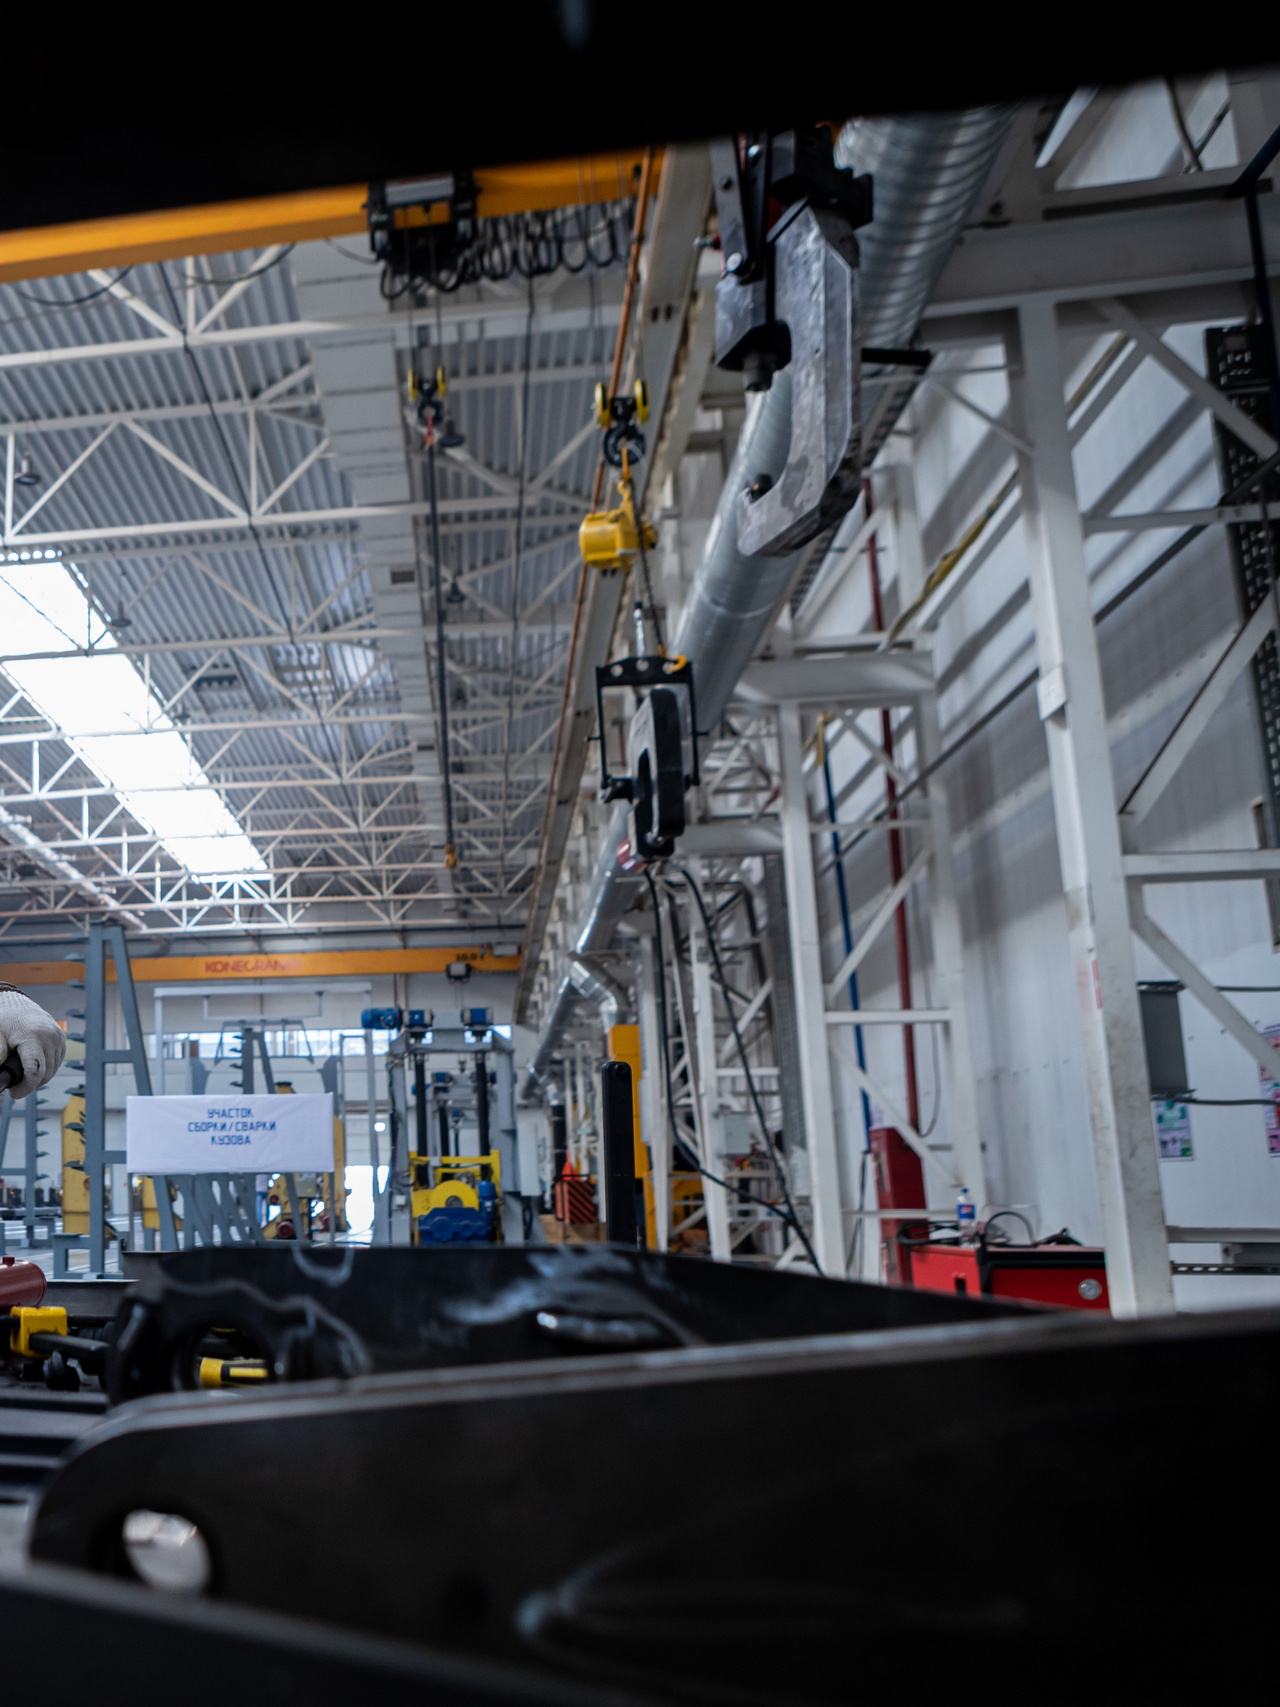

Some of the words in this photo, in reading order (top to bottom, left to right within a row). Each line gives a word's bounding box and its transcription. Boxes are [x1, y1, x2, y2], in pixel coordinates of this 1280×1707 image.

[205, 958, 302, 973] KONECRAN
[207, 1108, 253, 1118] УЧАСТОК
[211, 1135, 251, 1145] КУЗОВА
